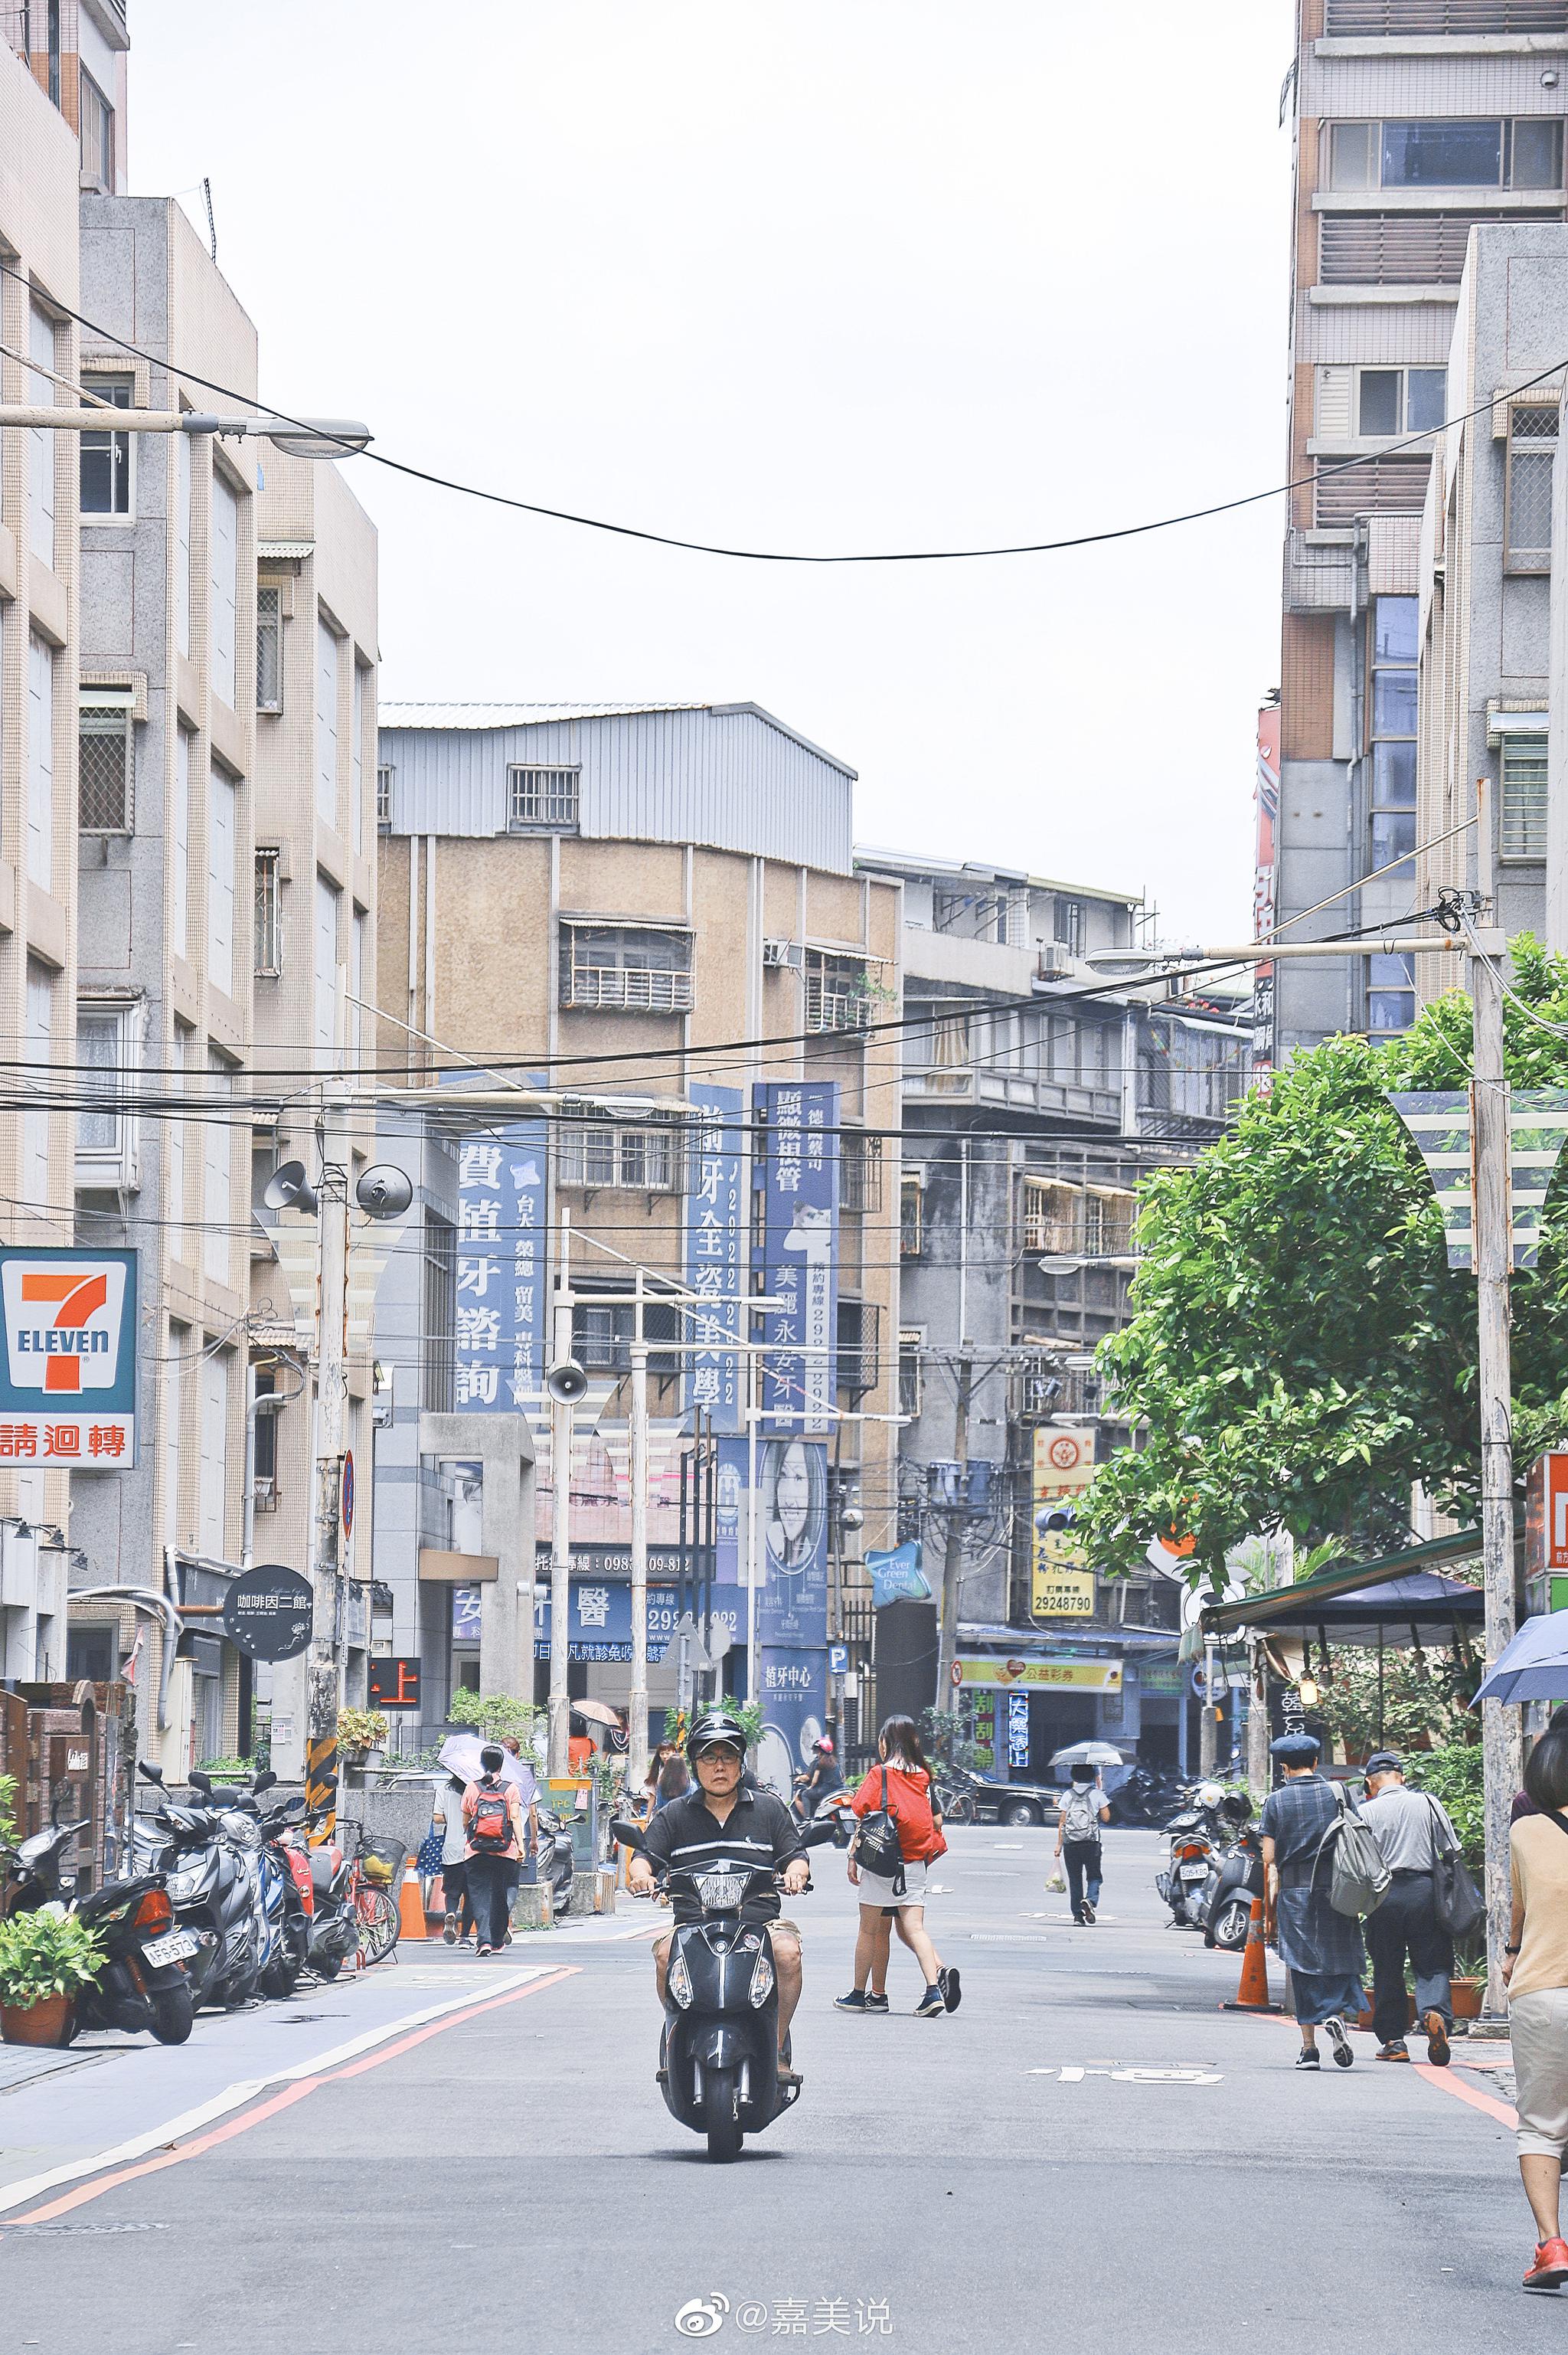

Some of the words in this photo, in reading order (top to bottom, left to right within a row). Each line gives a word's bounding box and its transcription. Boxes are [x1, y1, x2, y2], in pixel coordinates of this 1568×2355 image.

[514, 1286, 534, 1323] 留美
[0, 1423, 126, 1458] 請迴轉
[890, 1561, 910, 1569] Ever
[877, 1568, 908, 1578] Green
[884, 1580, 916, 1590] Dental
[237, 1595, 306, 1609] 咖啡因二館
[1036, 1597, 1090, 1611] 29248790
[831, 1649, 845, 1667] P
[766, 1666, 812, 1688] 植牙中心
[1027, 1668, 1073, 1683] 公益彩券
